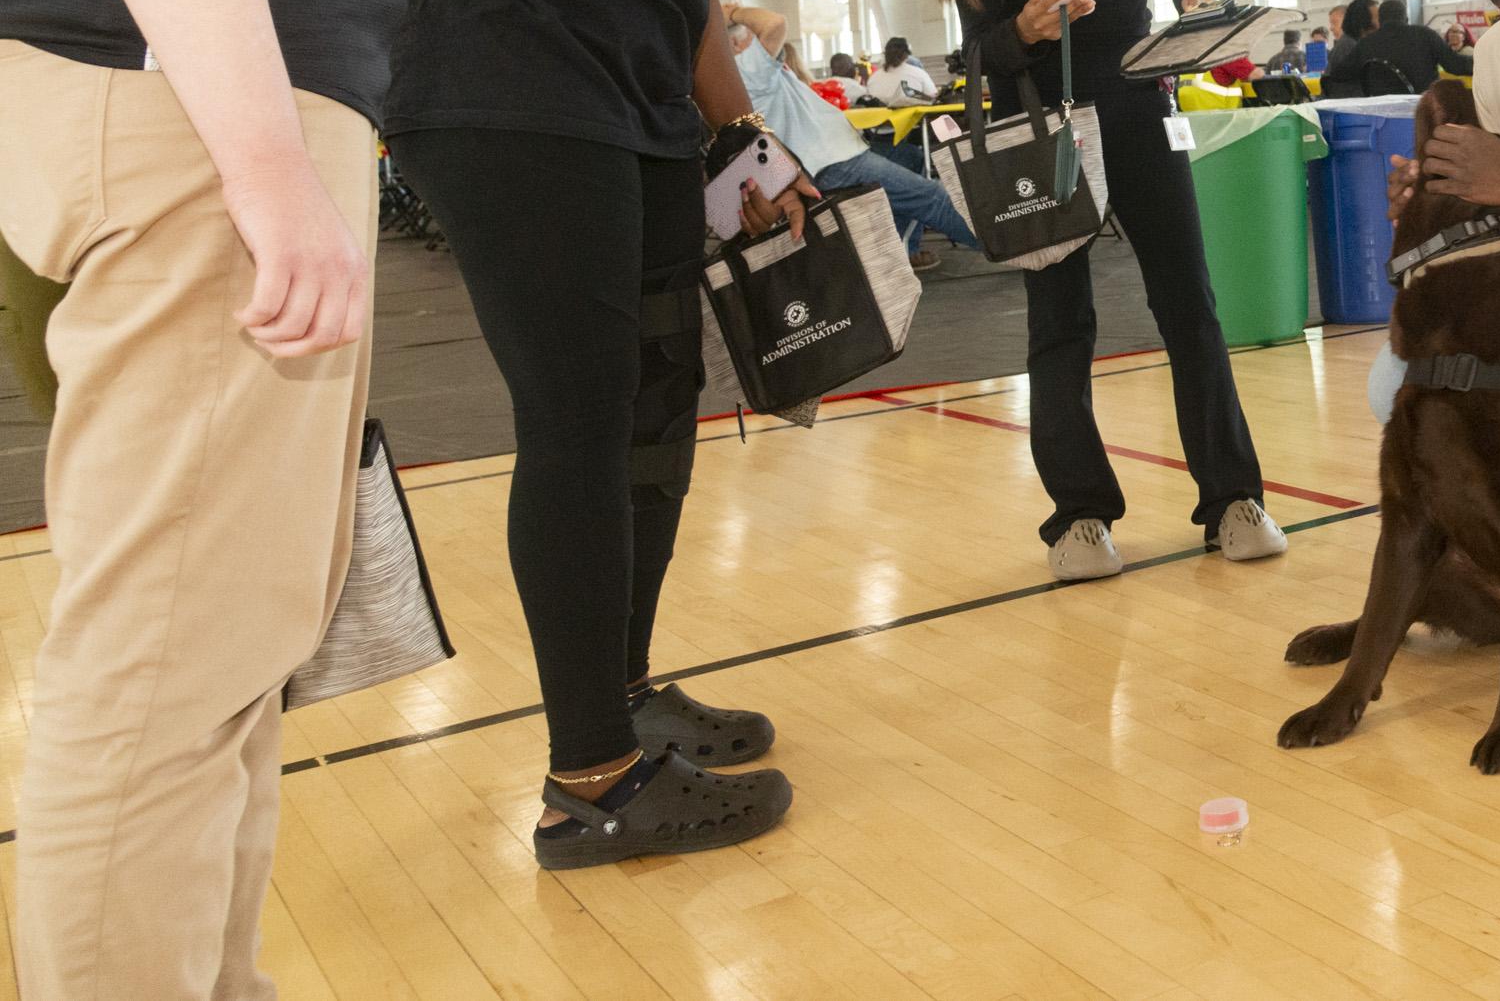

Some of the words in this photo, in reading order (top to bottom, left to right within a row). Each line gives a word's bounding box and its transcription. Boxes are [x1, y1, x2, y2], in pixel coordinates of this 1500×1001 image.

[994, 199, 1061, 223] ADMINISTRATI
[1008, 197, 1039, 211] DIVISION
[1040, 195, 1049, 203] OF
[762, 317, 852, 366] ADMINISTRATION
[776, 325, 814, 348] DIVISION
[815, 319, 827, 330] OF
